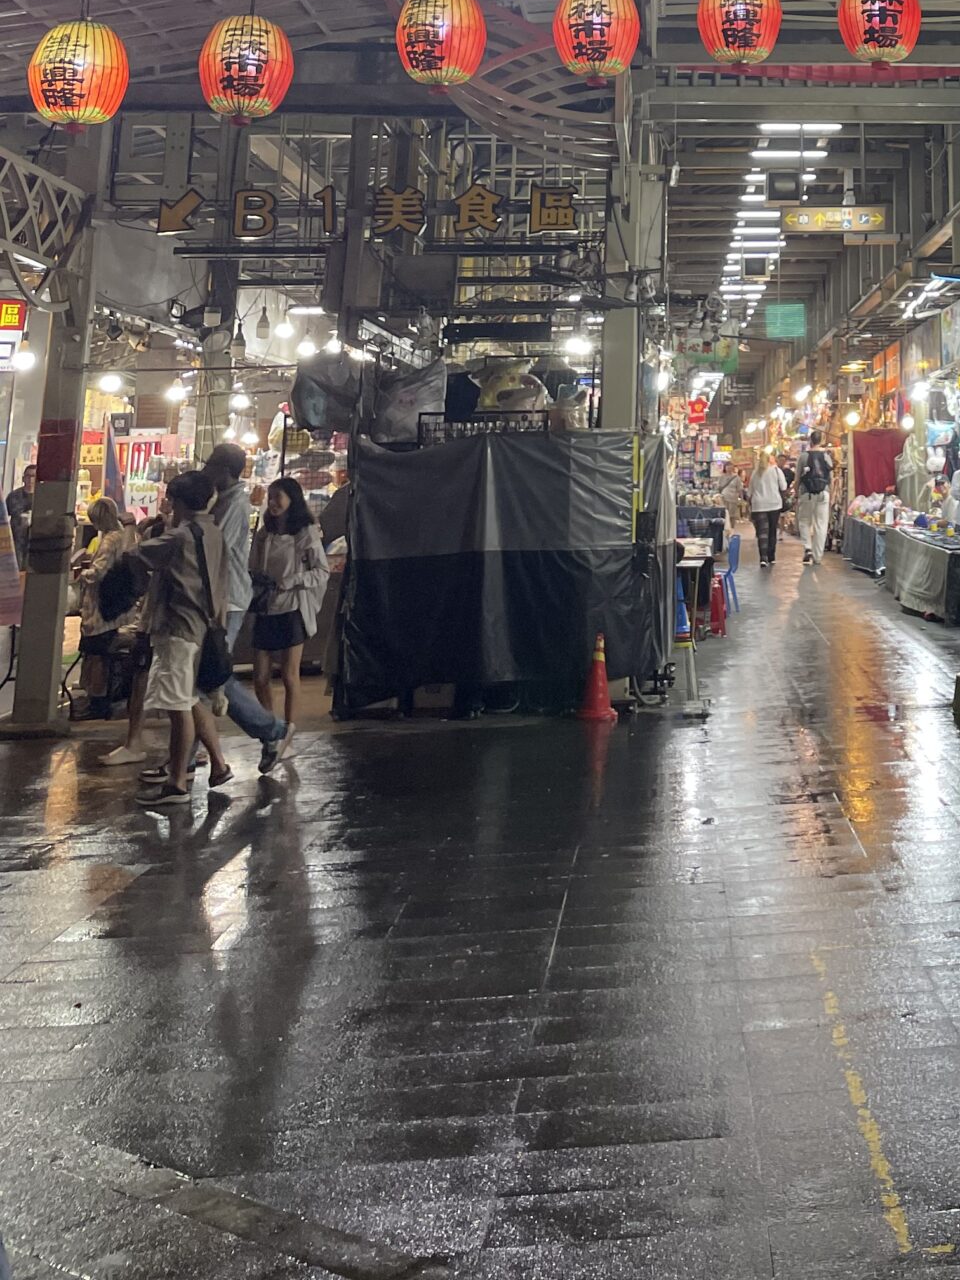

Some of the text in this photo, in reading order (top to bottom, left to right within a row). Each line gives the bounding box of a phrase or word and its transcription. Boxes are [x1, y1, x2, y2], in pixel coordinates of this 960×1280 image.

[219, 25, 271, 97] 士林市場
[130, 494, 158, 506] トイレ
